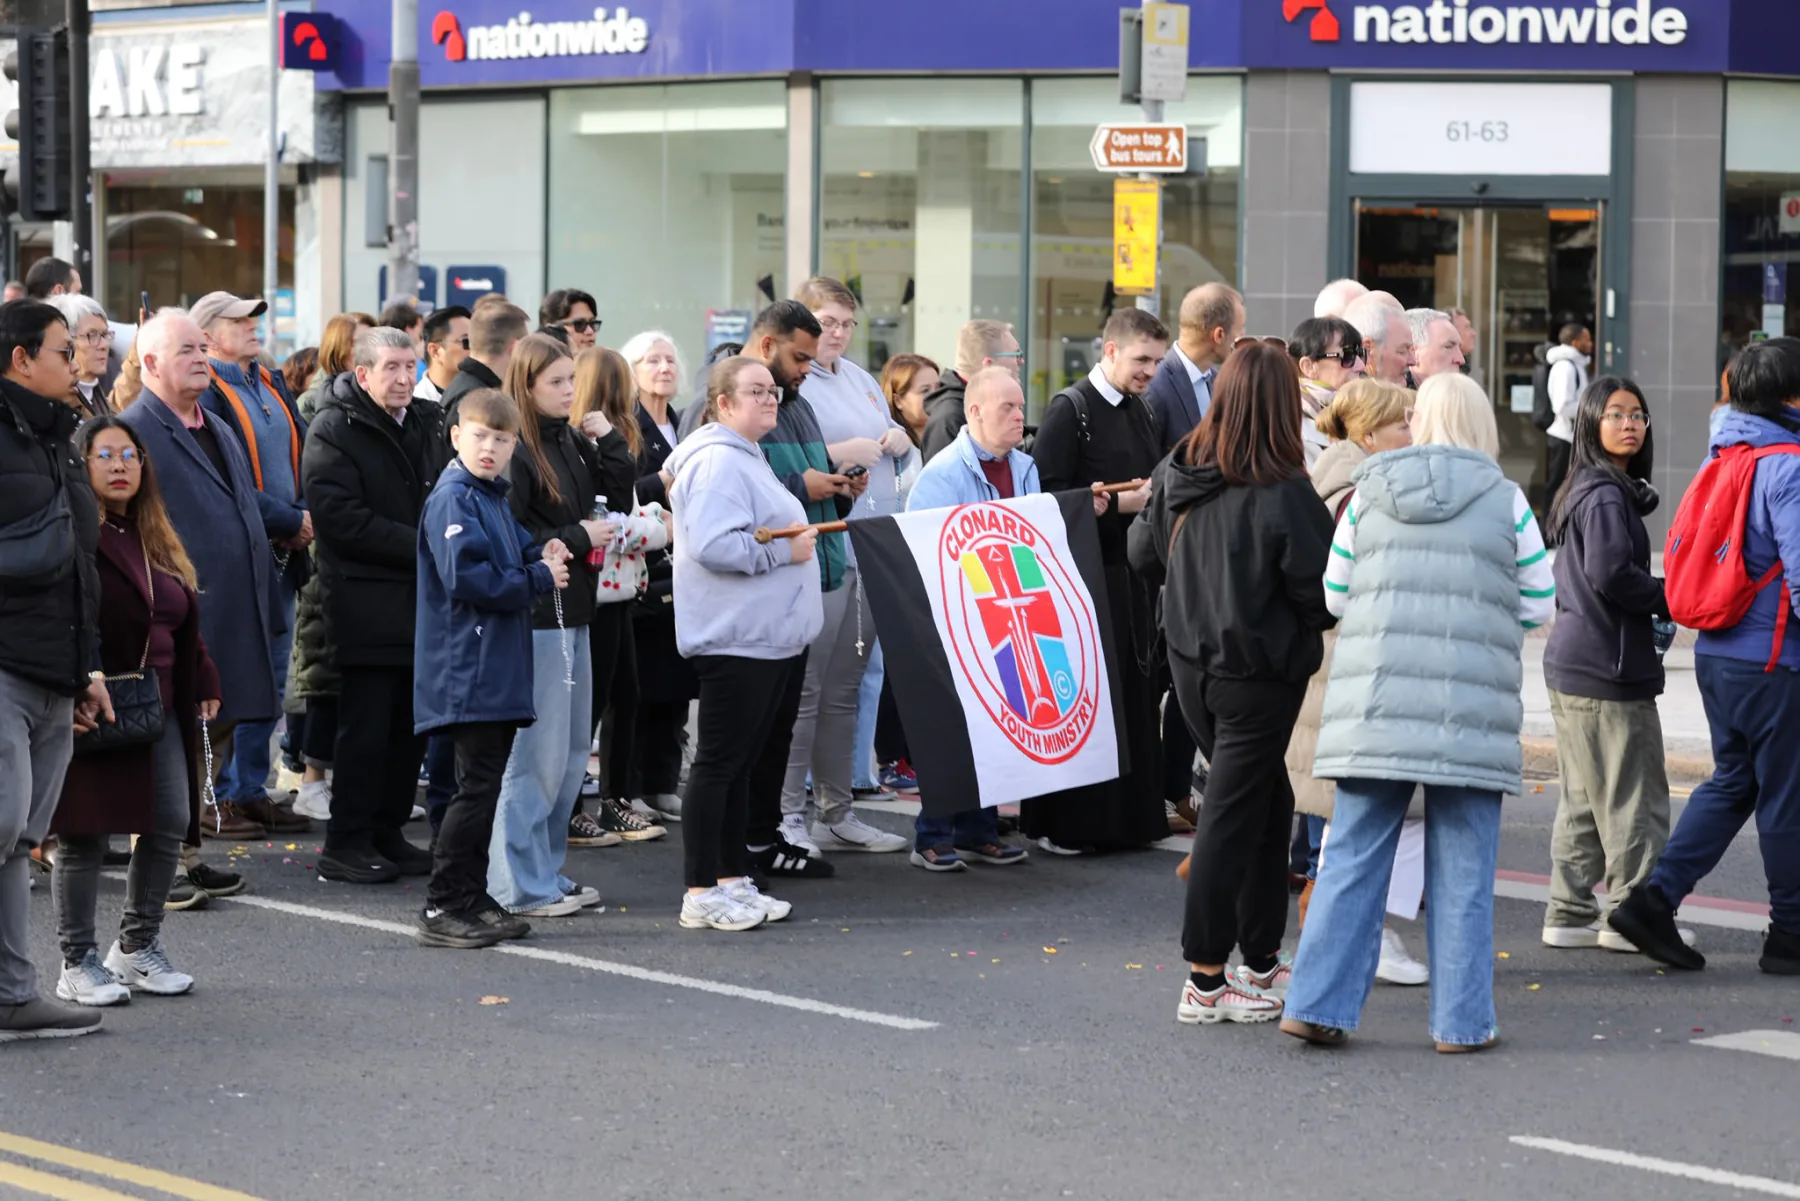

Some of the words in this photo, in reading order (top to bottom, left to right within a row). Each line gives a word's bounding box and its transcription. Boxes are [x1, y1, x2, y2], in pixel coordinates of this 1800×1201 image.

[467, 7, 649, 60] nationwide
[1353, 0, 1688, 45] nationwide
[1111, 130, 1141, 148] Open
[1143, 130, 1163, 148] top
[1445, 120, 1509, 142] 61-63
[1110, 147, 1131, 162] bus
[1133, 147, 1163, 162] tours
[946, 508, 1036, 562] CLONARD
[999, 703, 1041, 753] YOUTH
[1043, 692, 1095, 755] MINISTRY
